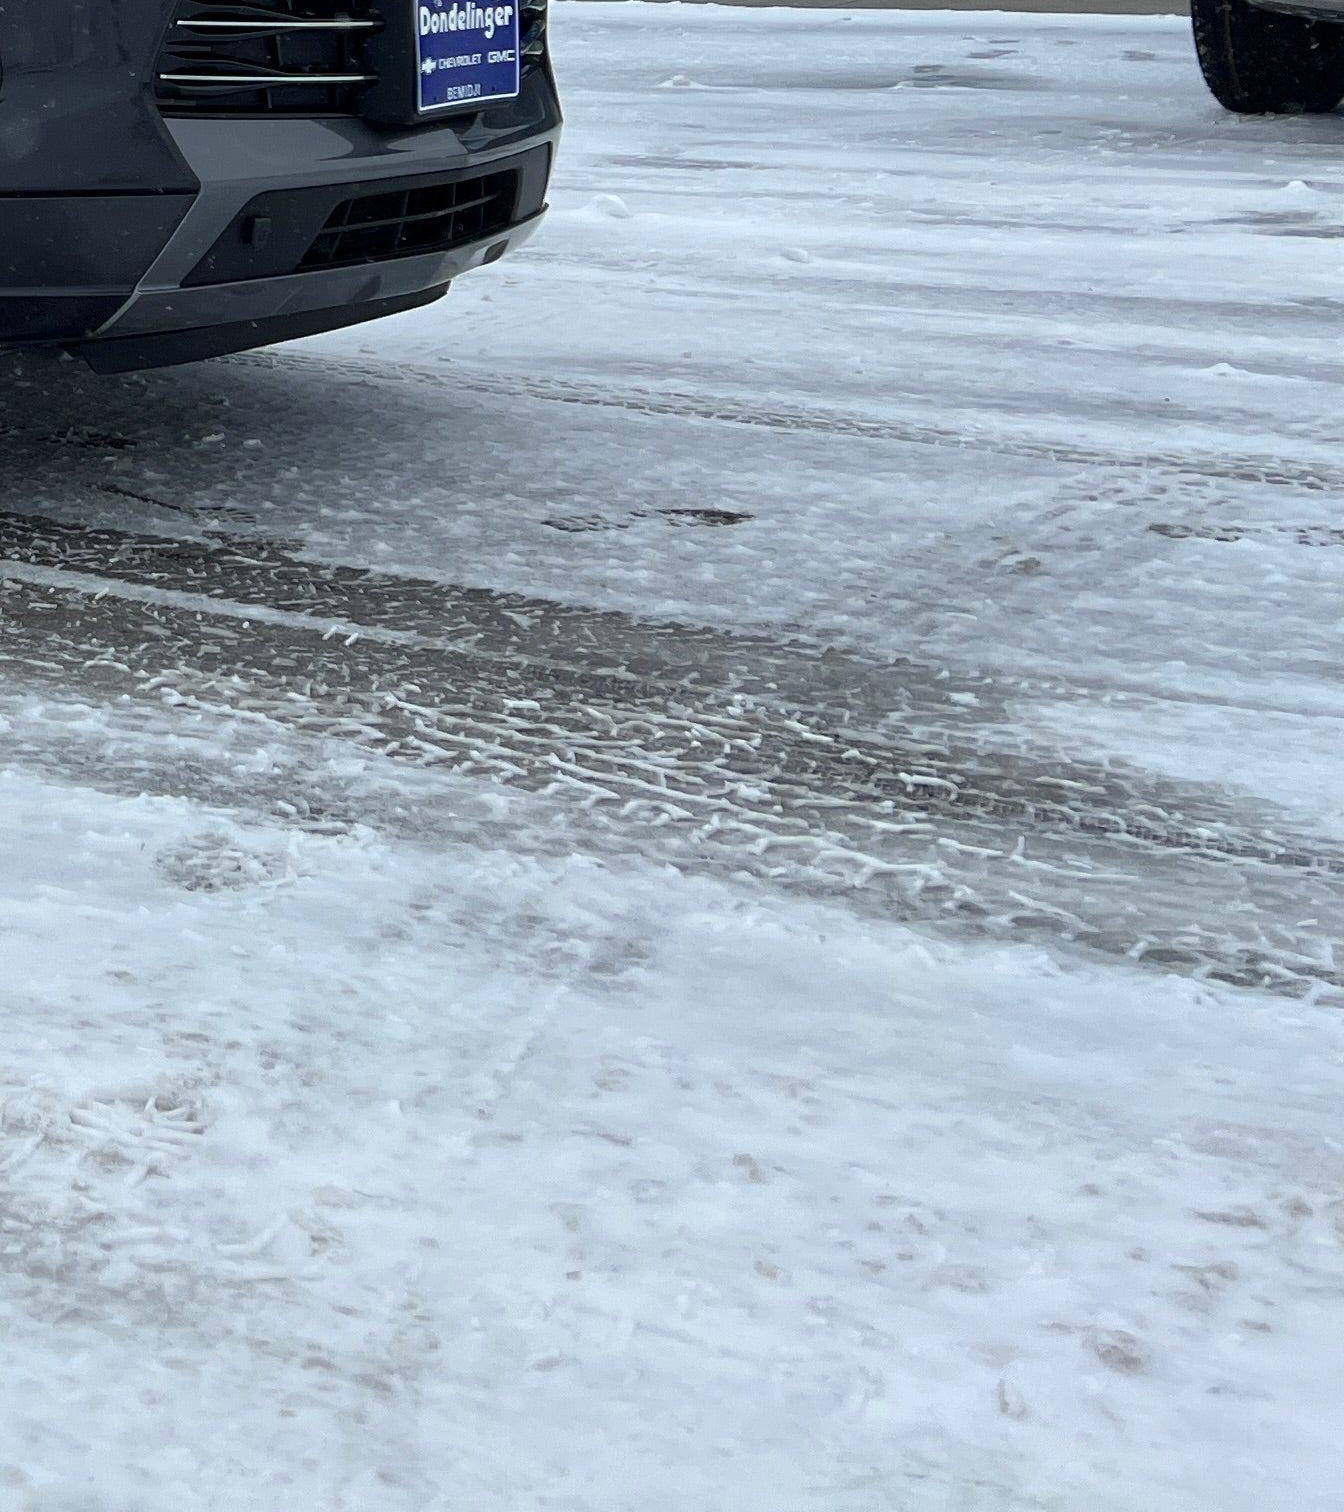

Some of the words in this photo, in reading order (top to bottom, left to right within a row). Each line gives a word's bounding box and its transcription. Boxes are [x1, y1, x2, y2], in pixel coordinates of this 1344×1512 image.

[419, 1, 514, 39] Dondelinger
[438, 53, 482, 70] CHEVROLET
[487, 50, 516, 64] GMC
[447, 83, 481, 100] BEMIDJI
